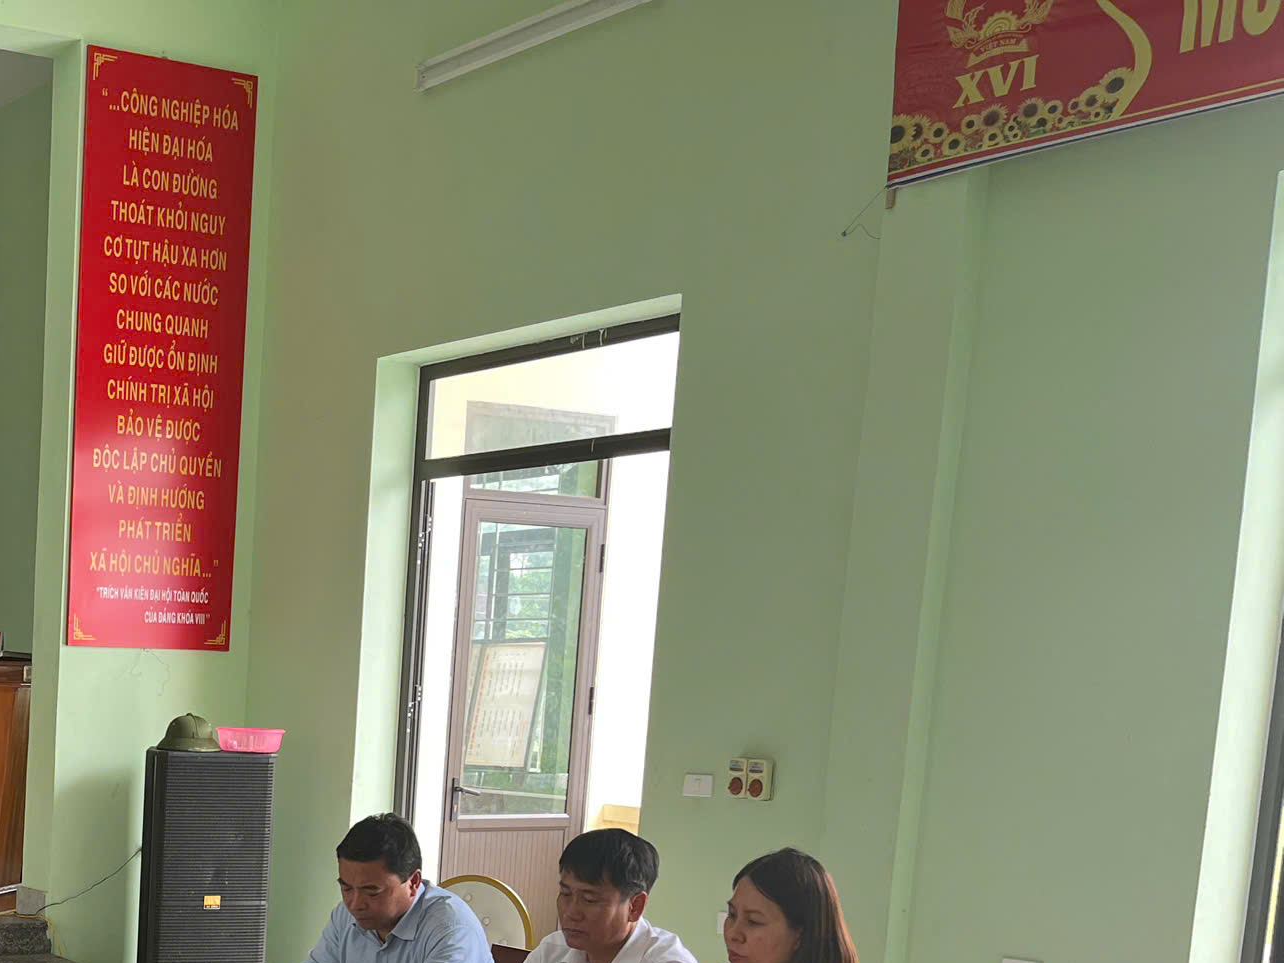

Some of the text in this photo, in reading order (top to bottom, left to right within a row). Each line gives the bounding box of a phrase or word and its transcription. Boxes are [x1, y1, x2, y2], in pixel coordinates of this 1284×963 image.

[952, 54, 1039, 109] XVI
[162, 99, 210, 126] NGHIỆP
[214, 106, 239, 131] HÓA
[129, 127, 213, 162] HIỆN ĐẠI HÓA
[123, 161, 217, 199] LÀ CON ĐƯỜNG
[111, 199, 226, 236] THOÁT KHỎI NGUY
[104, 234, 227, 271] CƠ TỤT HẬU XA HƠN
[109, 270, 218, 305] SO VỚI CÁC NƯỚC
[117, 309, 208, 338] CHUNG QUANH
[104, 338, 218, 377] GIỮ ĐƯỢC ỔN ĐỊNH
[108, 376, 214, 414] CHÍNH TRỊ XÃ HỘI
[117, 409, 200, 442] BẢO VỆ ĐƯỢC
[93, 445, 221, 478] ĐỘC LẬP CHỦ QUYỀN
[108, 482, 205, 511] VÀ ĐỊNH HƯỚNG
[119, 513, 191, 542] PHÁT TRIỂN
[109, 550, 131, 575] HỘI
[134, 549, 160, 575] CHỦ
